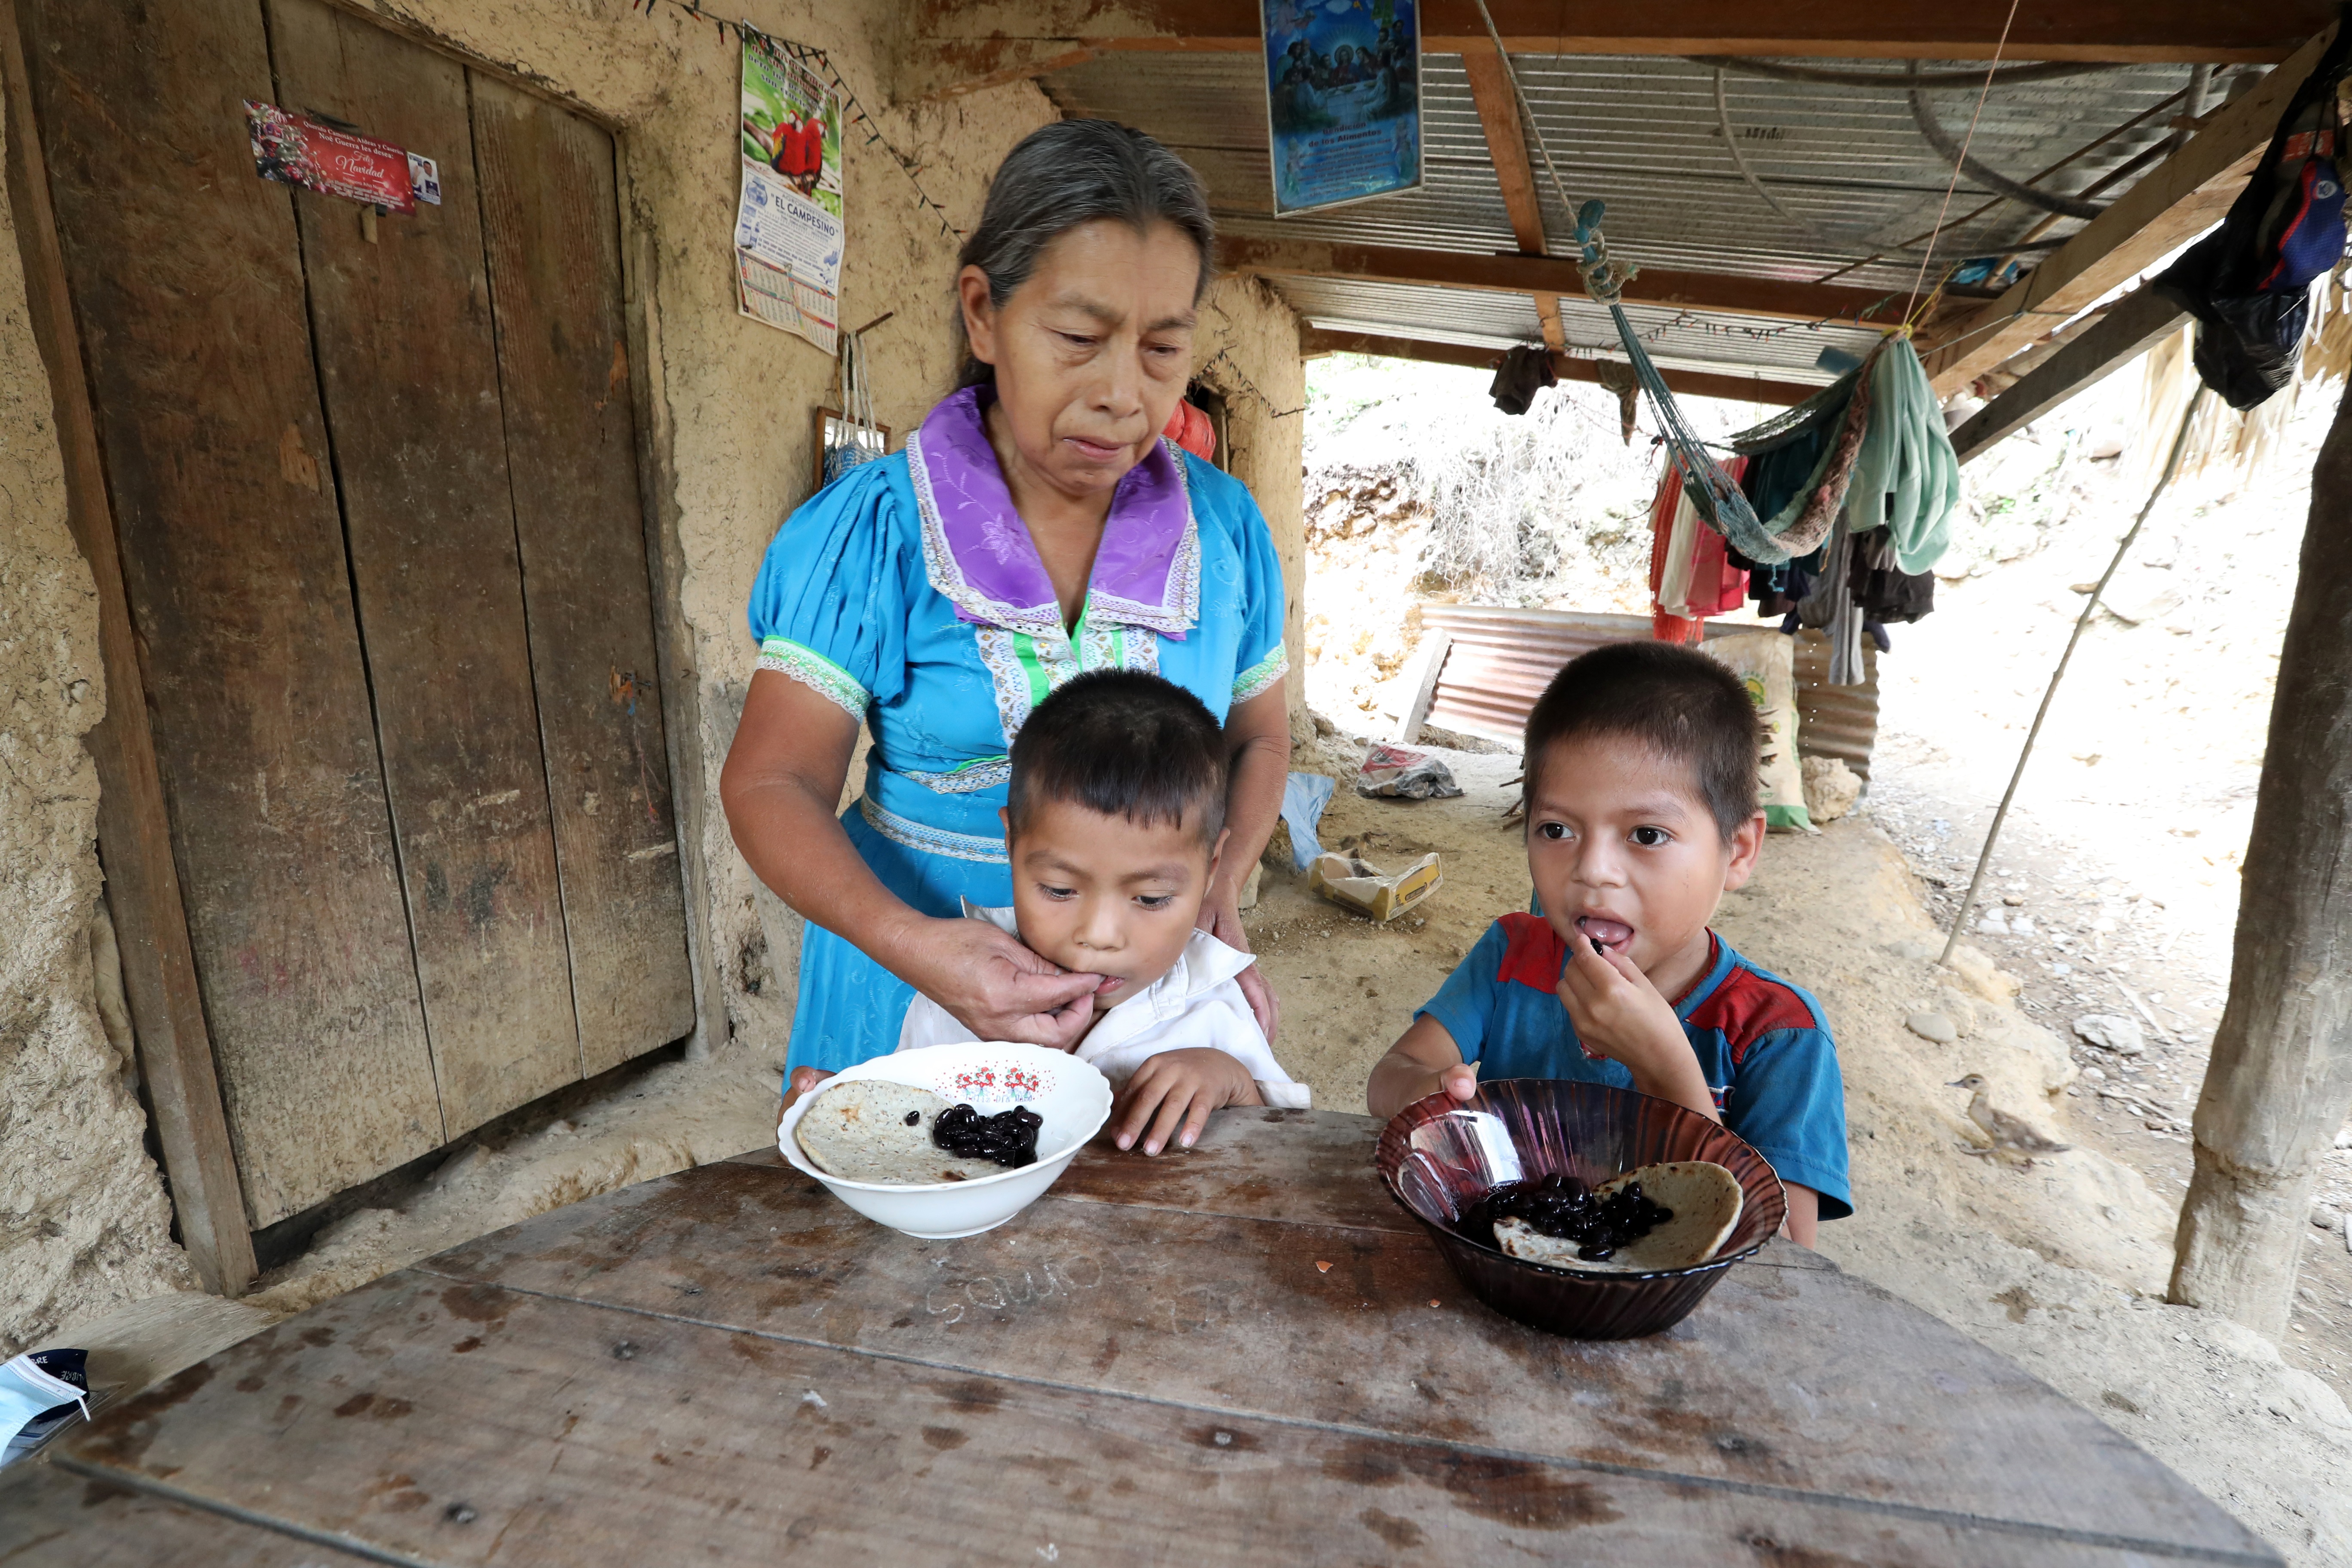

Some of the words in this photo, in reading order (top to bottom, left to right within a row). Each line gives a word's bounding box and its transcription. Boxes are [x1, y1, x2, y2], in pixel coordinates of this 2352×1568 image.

[748, 53, 769, 71] pero
[751, 44, 765, 57] de
[768, 56, 784, 71] sus
[761, 74, 777, 88] son
[303, 120, 327, 132] Querido
[357, 137, 377, 147] Aldeas
[1338, 129, 1382, 142] Alimentos
[335, 137, 360, 150] Guerra
[361, 144, 372, 153] les
[373, 148, 394, 159] desea:
[352, 150, 375, 166] Feliz
[335, 155, 384, 178] Navidad
